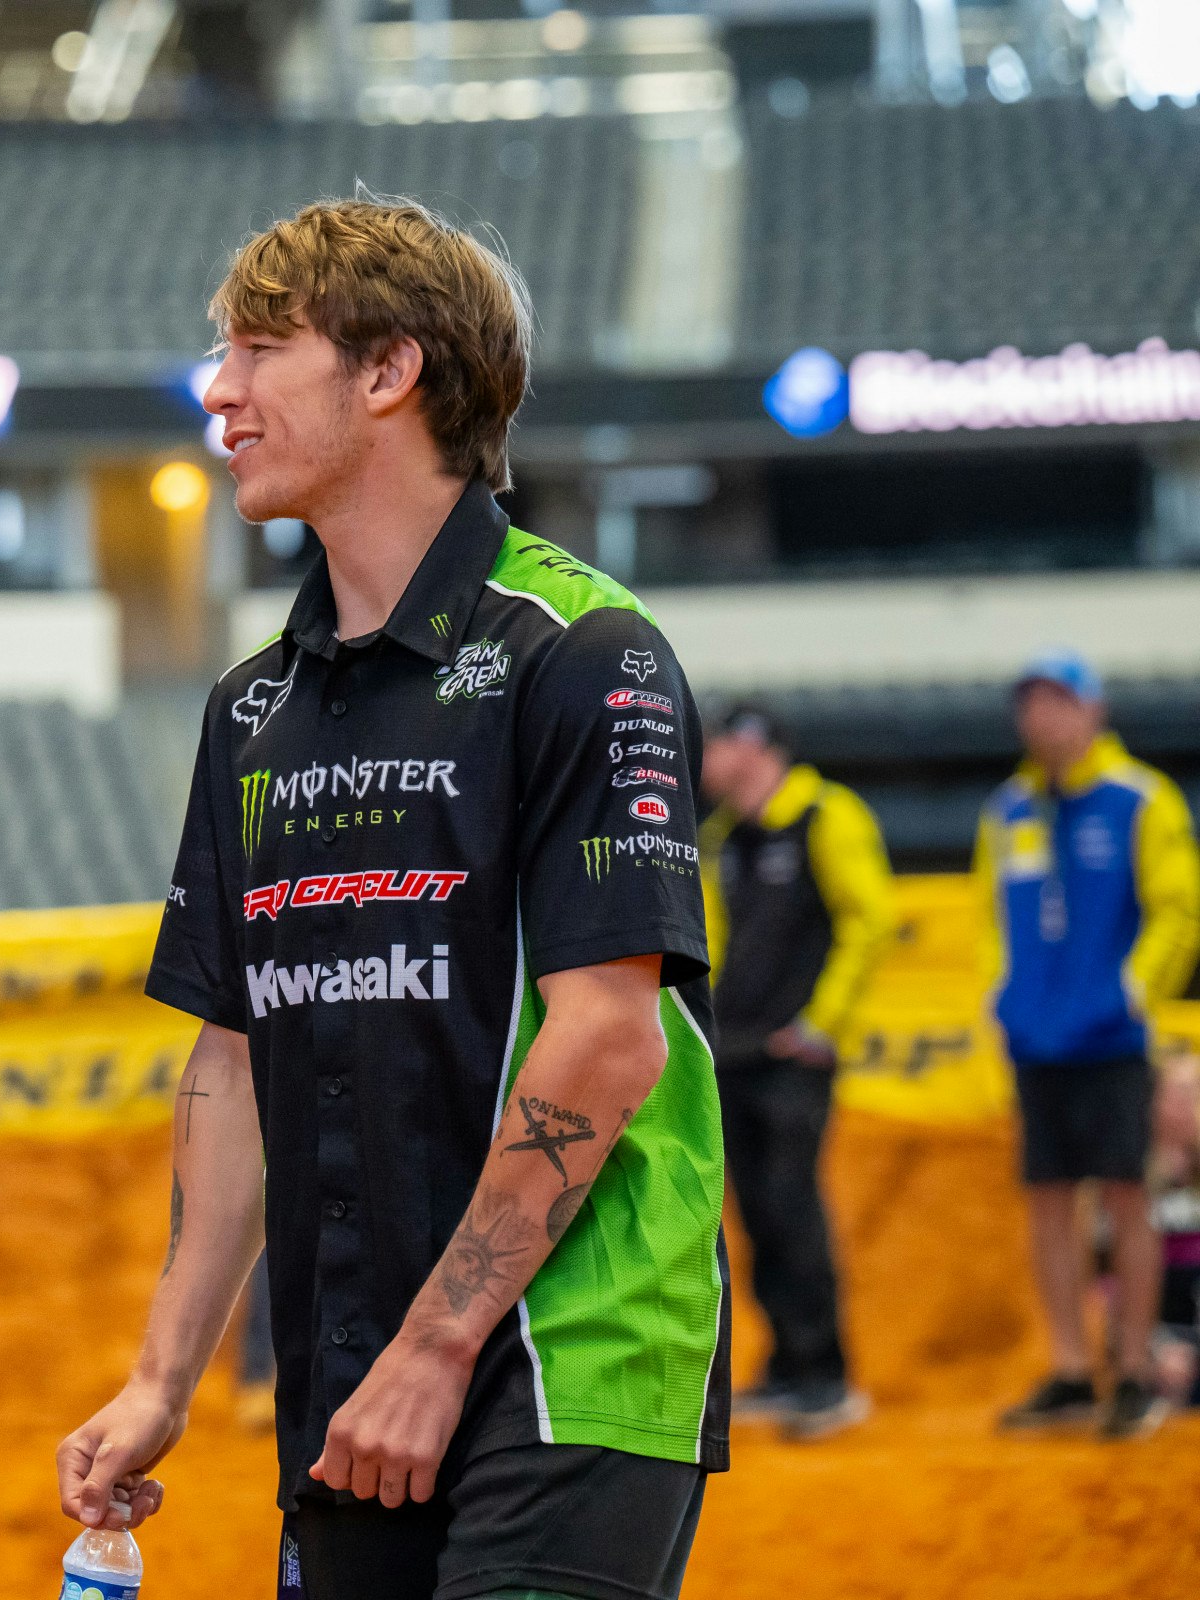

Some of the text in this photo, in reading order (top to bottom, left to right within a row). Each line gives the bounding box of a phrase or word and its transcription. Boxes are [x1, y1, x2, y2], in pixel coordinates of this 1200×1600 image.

[439, 657, 509, 700] GREN
[611, 718, 674, 735] DUNLOP
[626, 743, 677, 760] SCOTT
[272, 754, 461, 810] MONSTER
[636, 768, 679, 786] RENTHAL
[284, 809, 407, 835] ENERGY
[637, 801, 667, 819] BELL
[615, 831, 699, 866] MONSTER
[635, 858, 694, 877] ENERGY
[290, 870, 470, 908] CIRCUIT
[246, 944, 450, 1019] Kwasaki
